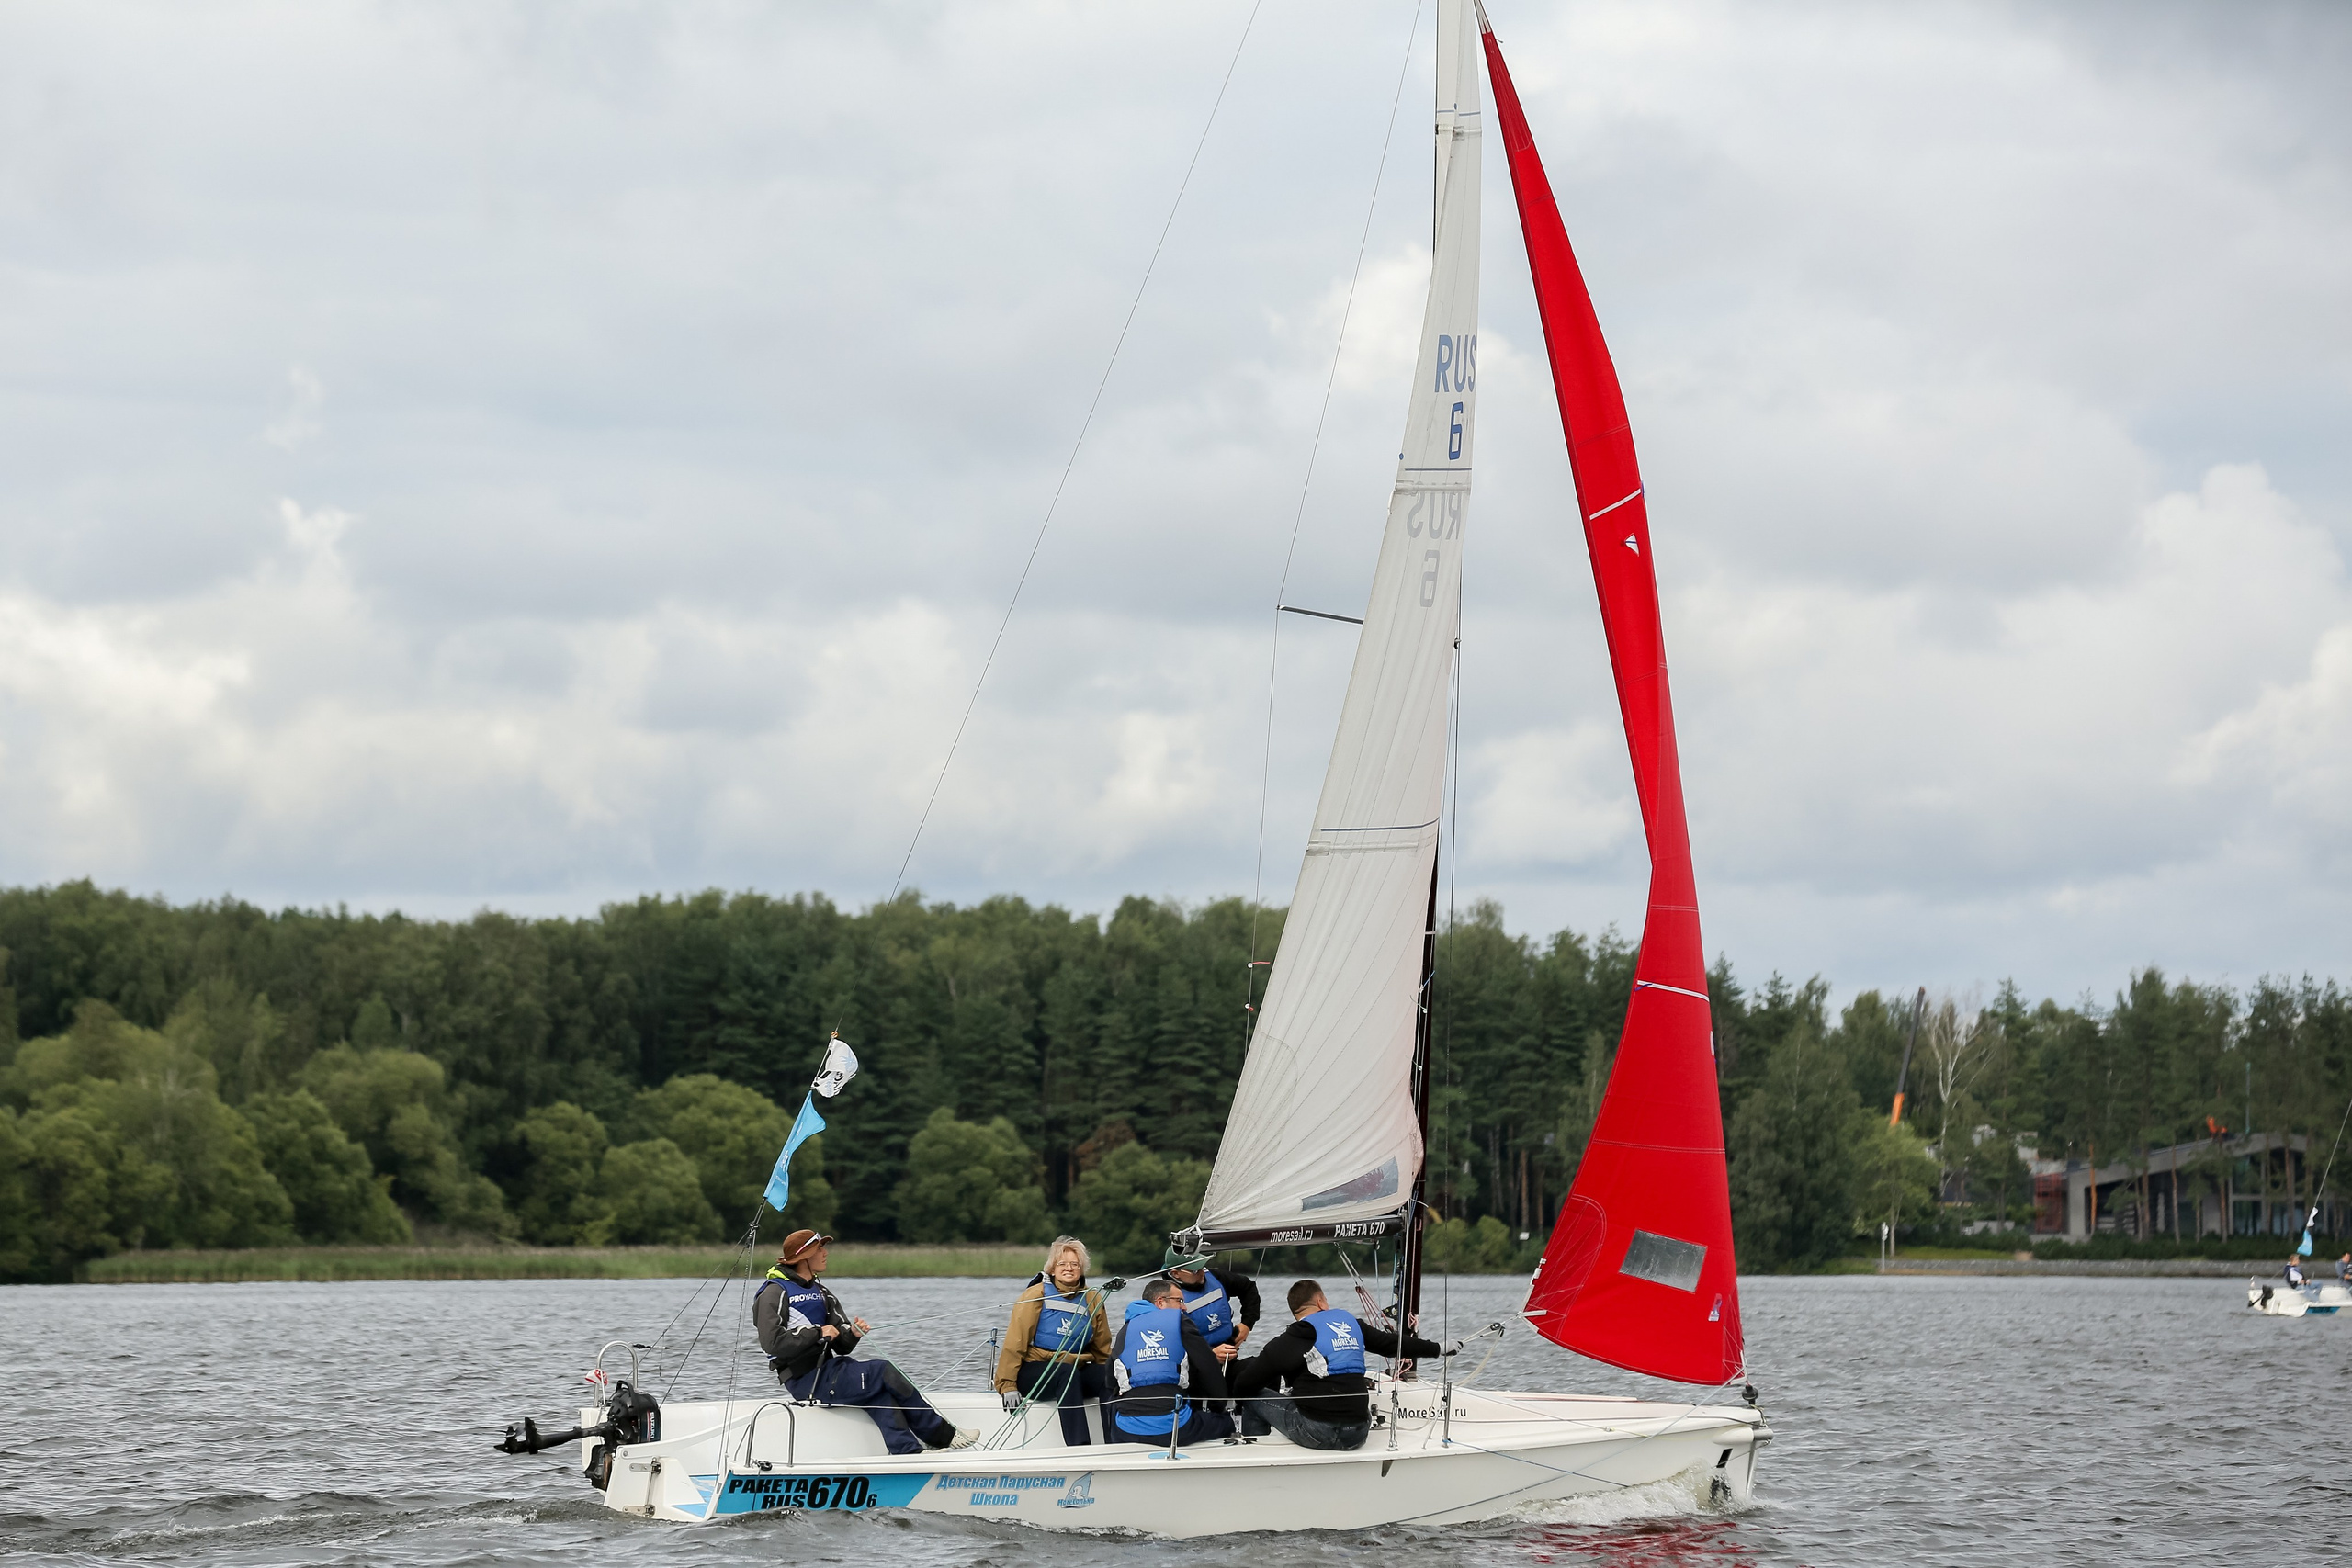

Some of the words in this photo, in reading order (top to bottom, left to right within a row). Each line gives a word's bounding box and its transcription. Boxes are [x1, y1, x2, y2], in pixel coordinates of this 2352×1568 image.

[1434, 334, 1476, 393] RUS
[1448, 401, 1464, 460] 6
[1369, 1221, 1385, 1235] 670
[1136, 1347, 1170, 1358] MORESAIL
[728, 1478, 808, 1494] РАКЕТА
[936, 1474, 998, 1489] Детская
[999, 1473, 1066, 1489] Парусная
[807, 1476, 870, 1509] 670
[866, 1494, 878, 1508] 6
[969, 1492, 1018, 1506] Школа
[761, 1495, 806, 1509] RUS
